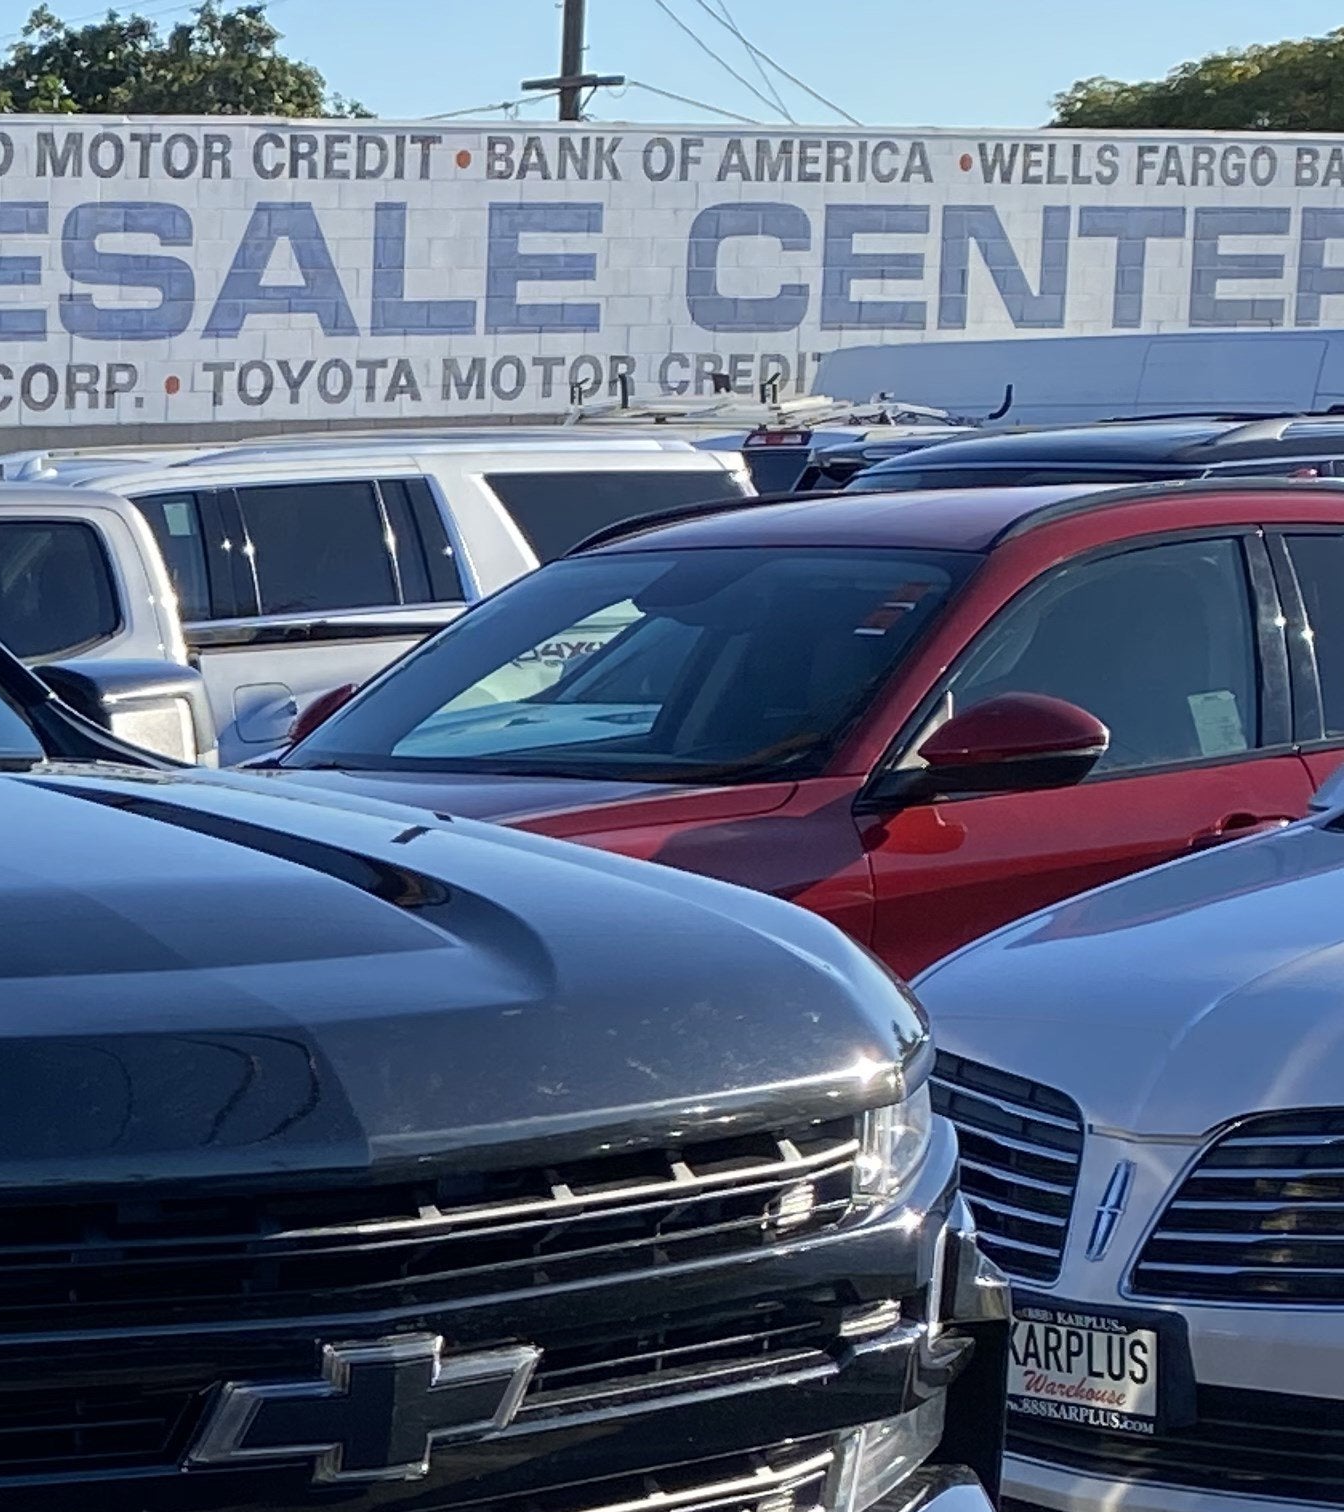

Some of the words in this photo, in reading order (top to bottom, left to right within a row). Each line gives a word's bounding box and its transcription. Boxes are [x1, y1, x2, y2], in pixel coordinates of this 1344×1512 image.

[36, 131, 232, 180] MOTOR
[253, 133, 443, 181] CREDIT
[486, 136, 624, 182] BANK
[642, 137, 705, 182] OF
[716, 138, 934, 184] AMERICA
[978, 142, 1119, 186] WELLS
[1136, 144, 1278, 187] FARGO
[203, 360, 420, 408] TOYOTA
[442, 356, 637, 402] MOTOR
[1023, 1370, 1126, 1406] Warehouse
